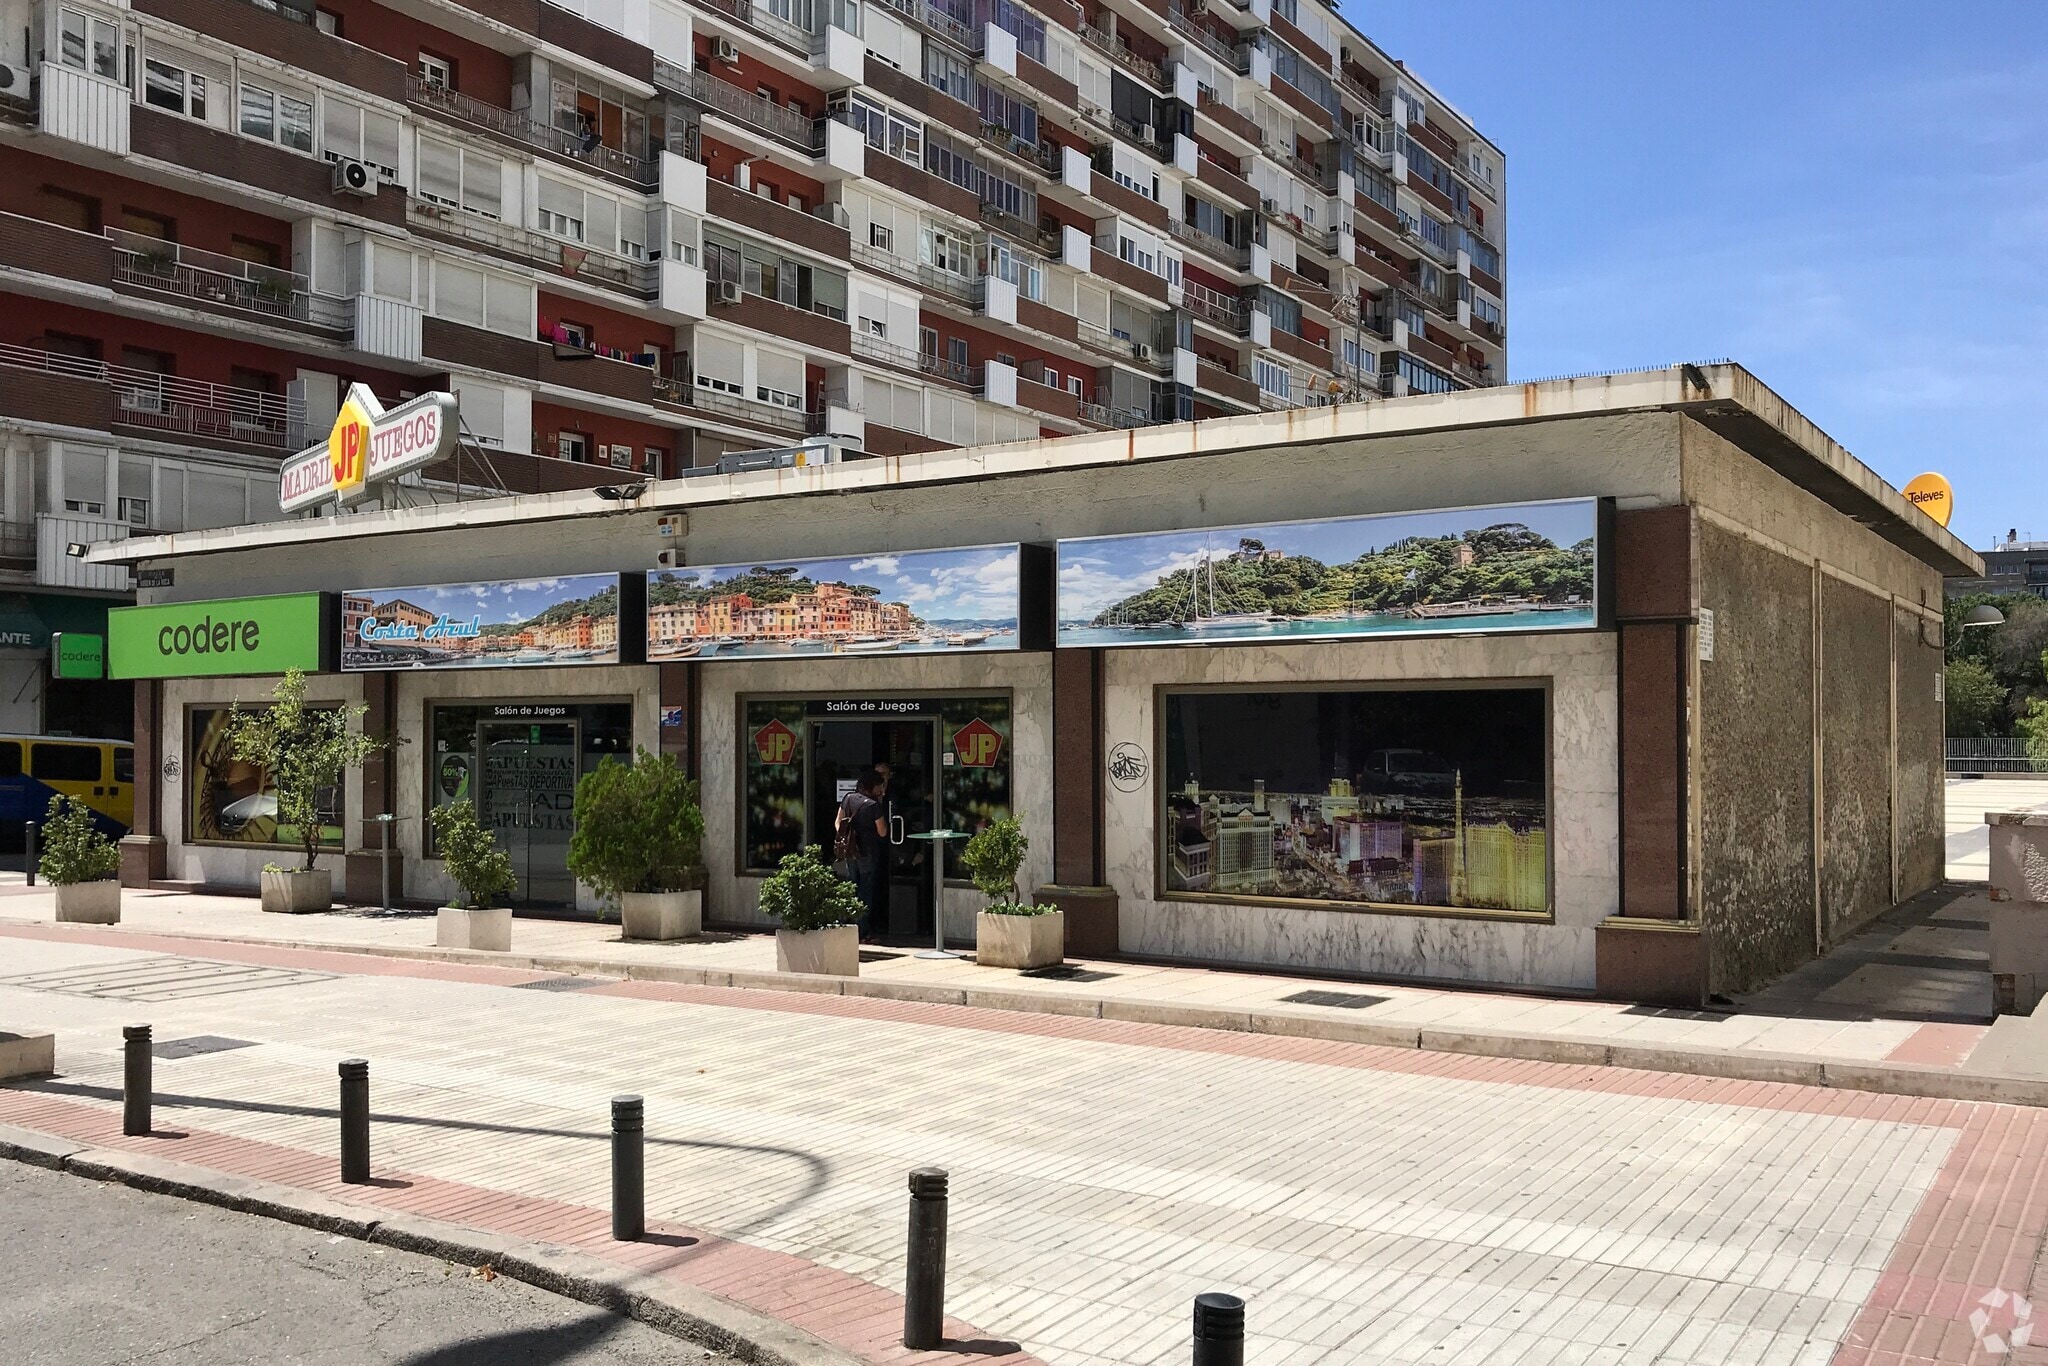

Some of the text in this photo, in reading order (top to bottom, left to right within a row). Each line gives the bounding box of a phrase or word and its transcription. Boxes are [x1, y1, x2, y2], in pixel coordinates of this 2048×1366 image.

[334, 421, 360, 482] JP
[370, 411, 436, 466] JUEGOS
[283, 455, 333, 501] MADRID
[1908, 490, 1944, 503] Televes
[0, 632, 31, 645] NTE
[159, 615, 260, 655] codere
[360, 614, 480, 640] Costa Azul
[61, 652, 101, 662] codere
[494, 705, 566, 717] Salón de Juegos
[825, 700, 920, 713] Salón de Juegos
[760, 733, 792, 762] JP
[960, 733, 997, 764] JP
